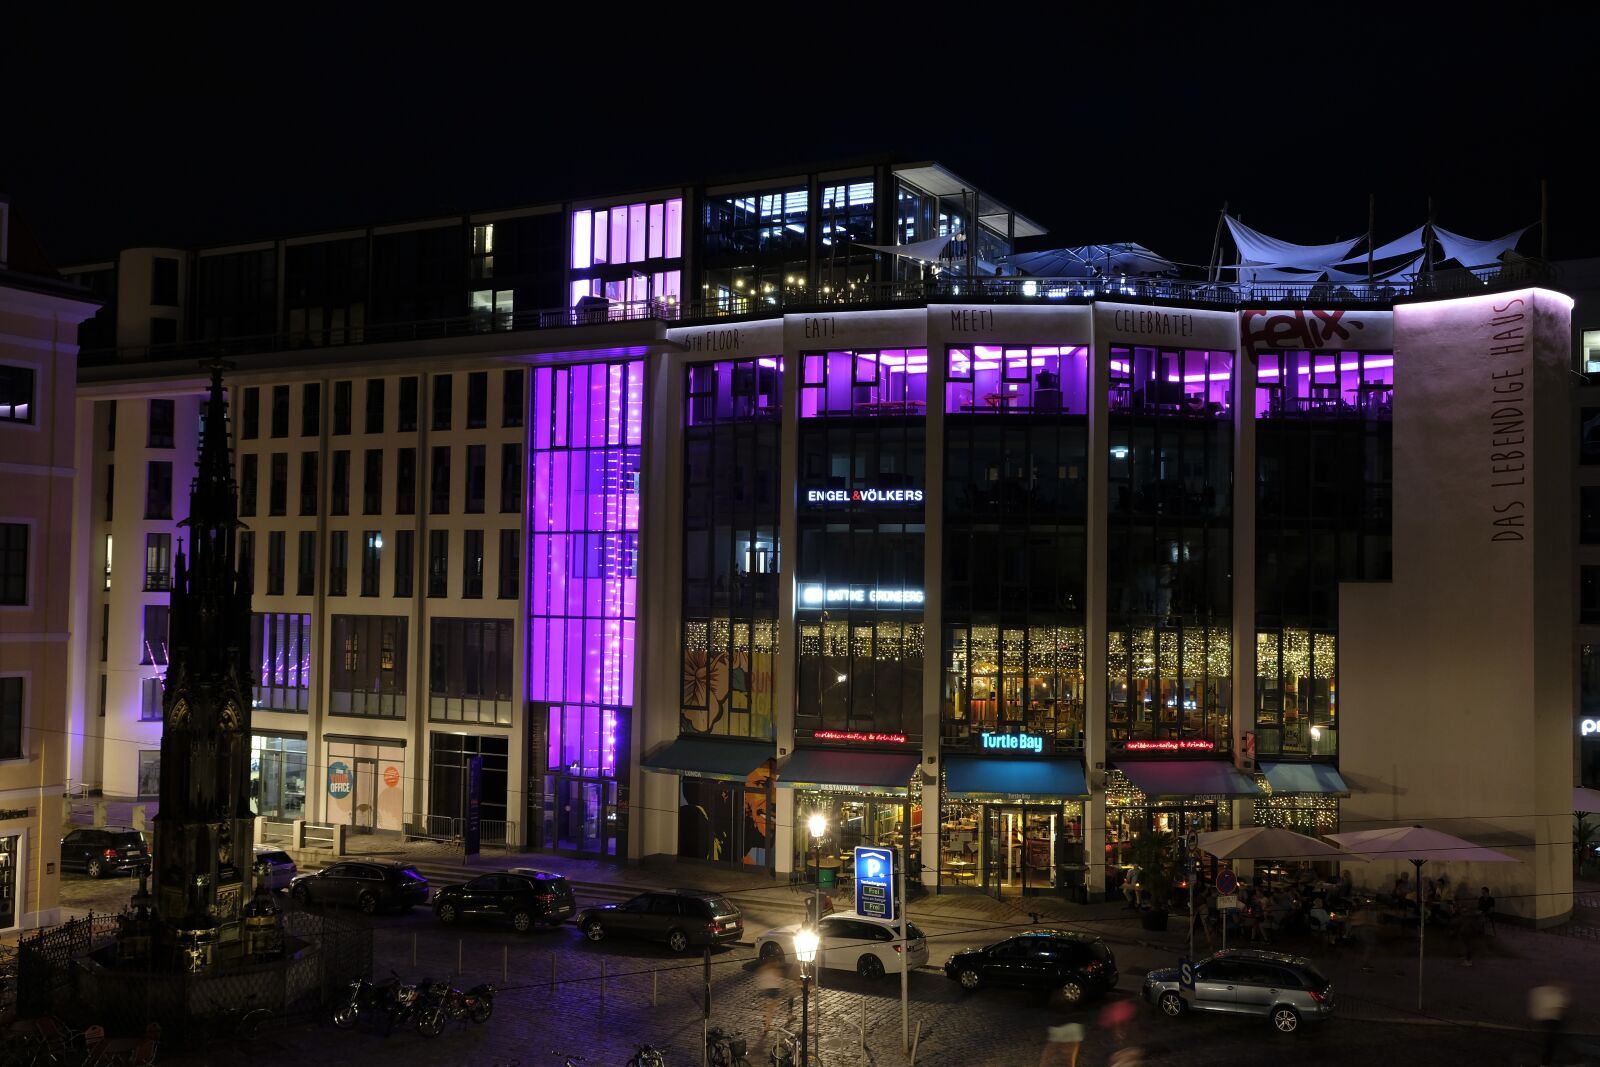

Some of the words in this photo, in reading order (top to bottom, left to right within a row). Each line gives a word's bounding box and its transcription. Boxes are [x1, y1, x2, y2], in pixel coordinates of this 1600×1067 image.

[805, 317, 836, 339] EAT!
[951, 309, 994, 333] MEET!
[1115, 309, 1194, 337] CELEBRATE!
[1490, 298, 1525, 356] HAUS
[706, 328, 745, 352] FLOOR:
[1490, 367, 1525, 487] LEBENDIGE
[1490, 502, 1525, 542] DAS
[981, 732, 1018, 748] Turtle
[1019, 733, 1043, 753] Bay
[330, 782, 350, 793] OFFICE
